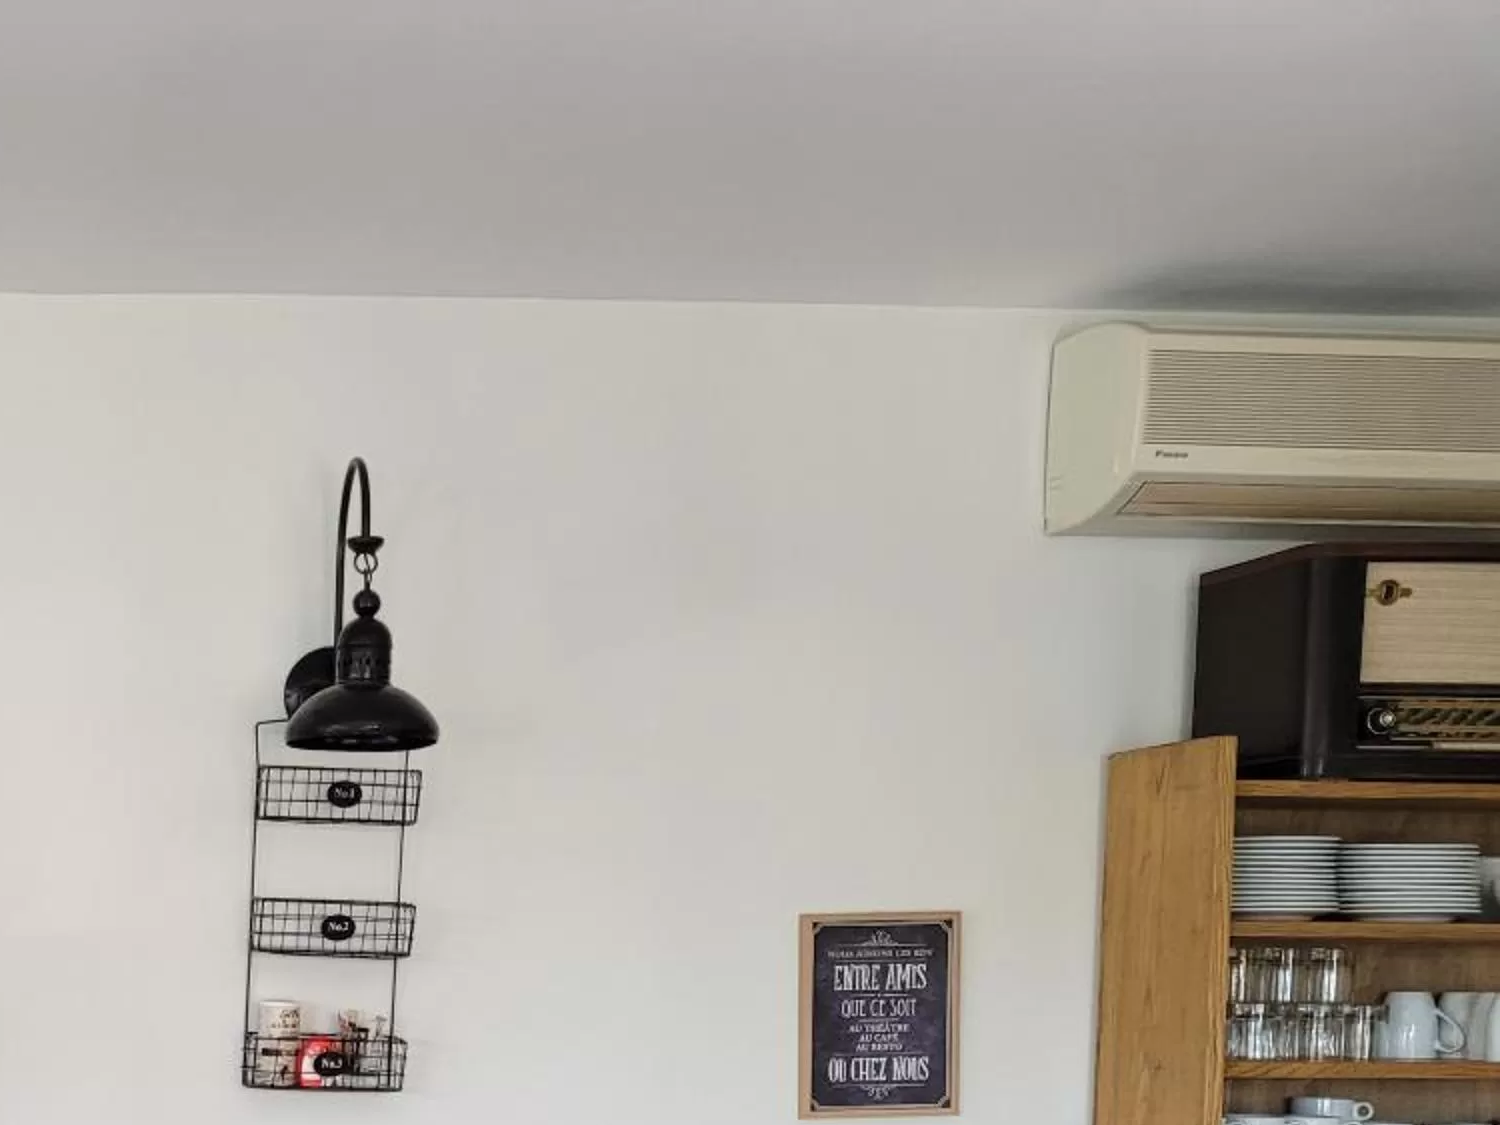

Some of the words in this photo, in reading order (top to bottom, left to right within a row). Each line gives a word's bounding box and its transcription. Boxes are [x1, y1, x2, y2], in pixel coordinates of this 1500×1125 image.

[833, 964, 880, 991] ENTRE
[885, 963, 927, 991] AMIS
[841, 999, 867, 1019] QUE
[869, 999, 886, 1017] CE
[889, 998, 917, 1017] SOIT
[828, 1058, 847, 1083] OU
[850, 1057, 887, 1081] CHEZ
[891, 1056, 929, 1081] NOUS
